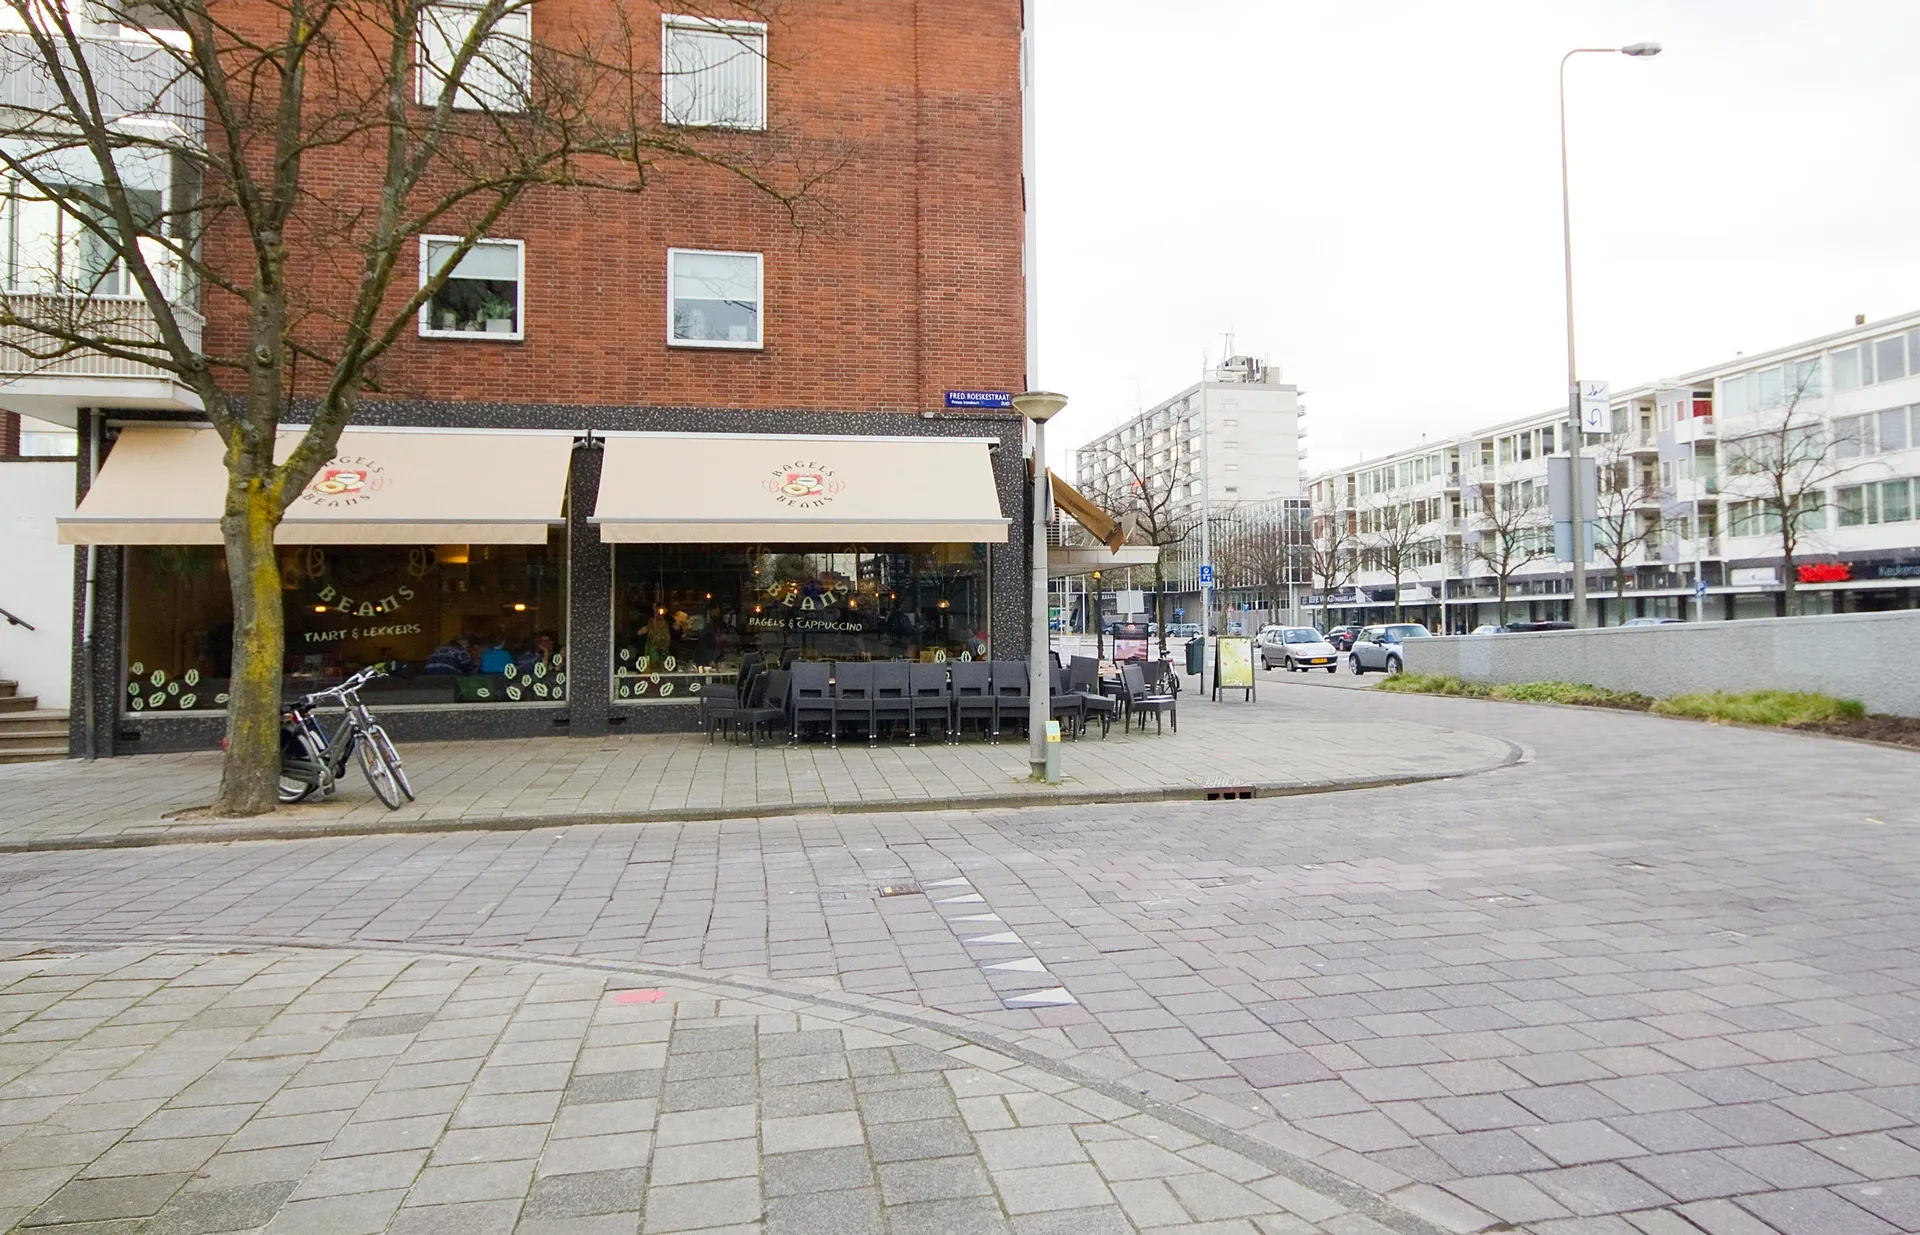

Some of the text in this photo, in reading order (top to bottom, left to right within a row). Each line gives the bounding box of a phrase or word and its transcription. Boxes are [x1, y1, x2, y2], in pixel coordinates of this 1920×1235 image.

[966, 392, 1010, 401] ROESKESTRAAT
[323, 456, 385, 474] AGELS
[772, 461, 836, 478] BAGELS
[302, 493, 371, 508] BEANS
[776, 495, 834, 509] BEANS
[317, 584, 415, 616] BEANS
[766, 581, 849, 610] BEANS
[304, 623, 422, 643] TAART & LEKKERS
[749, 617, 863, 632] BAGELS & CAPPUCCINO
